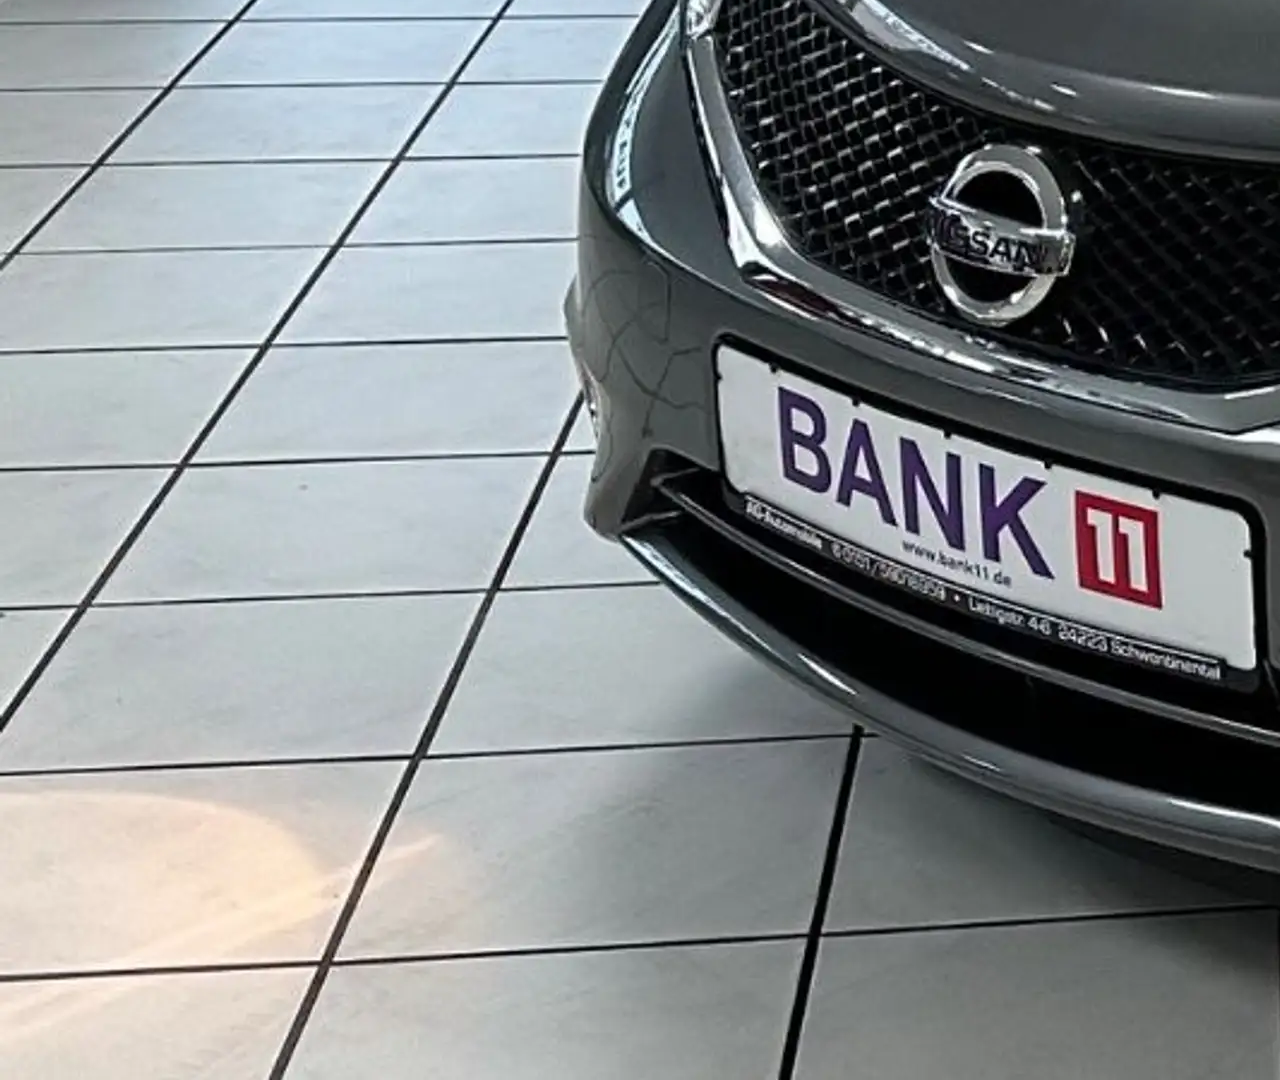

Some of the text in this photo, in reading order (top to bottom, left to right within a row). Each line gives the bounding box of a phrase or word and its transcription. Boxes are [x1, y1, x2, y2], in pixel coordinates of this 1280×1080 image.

[778, 386, 1152, 596] BANK 11
[902, 540, 1012, 588] www.bank11.de
[1057, 623, 1109, 653] 24223
